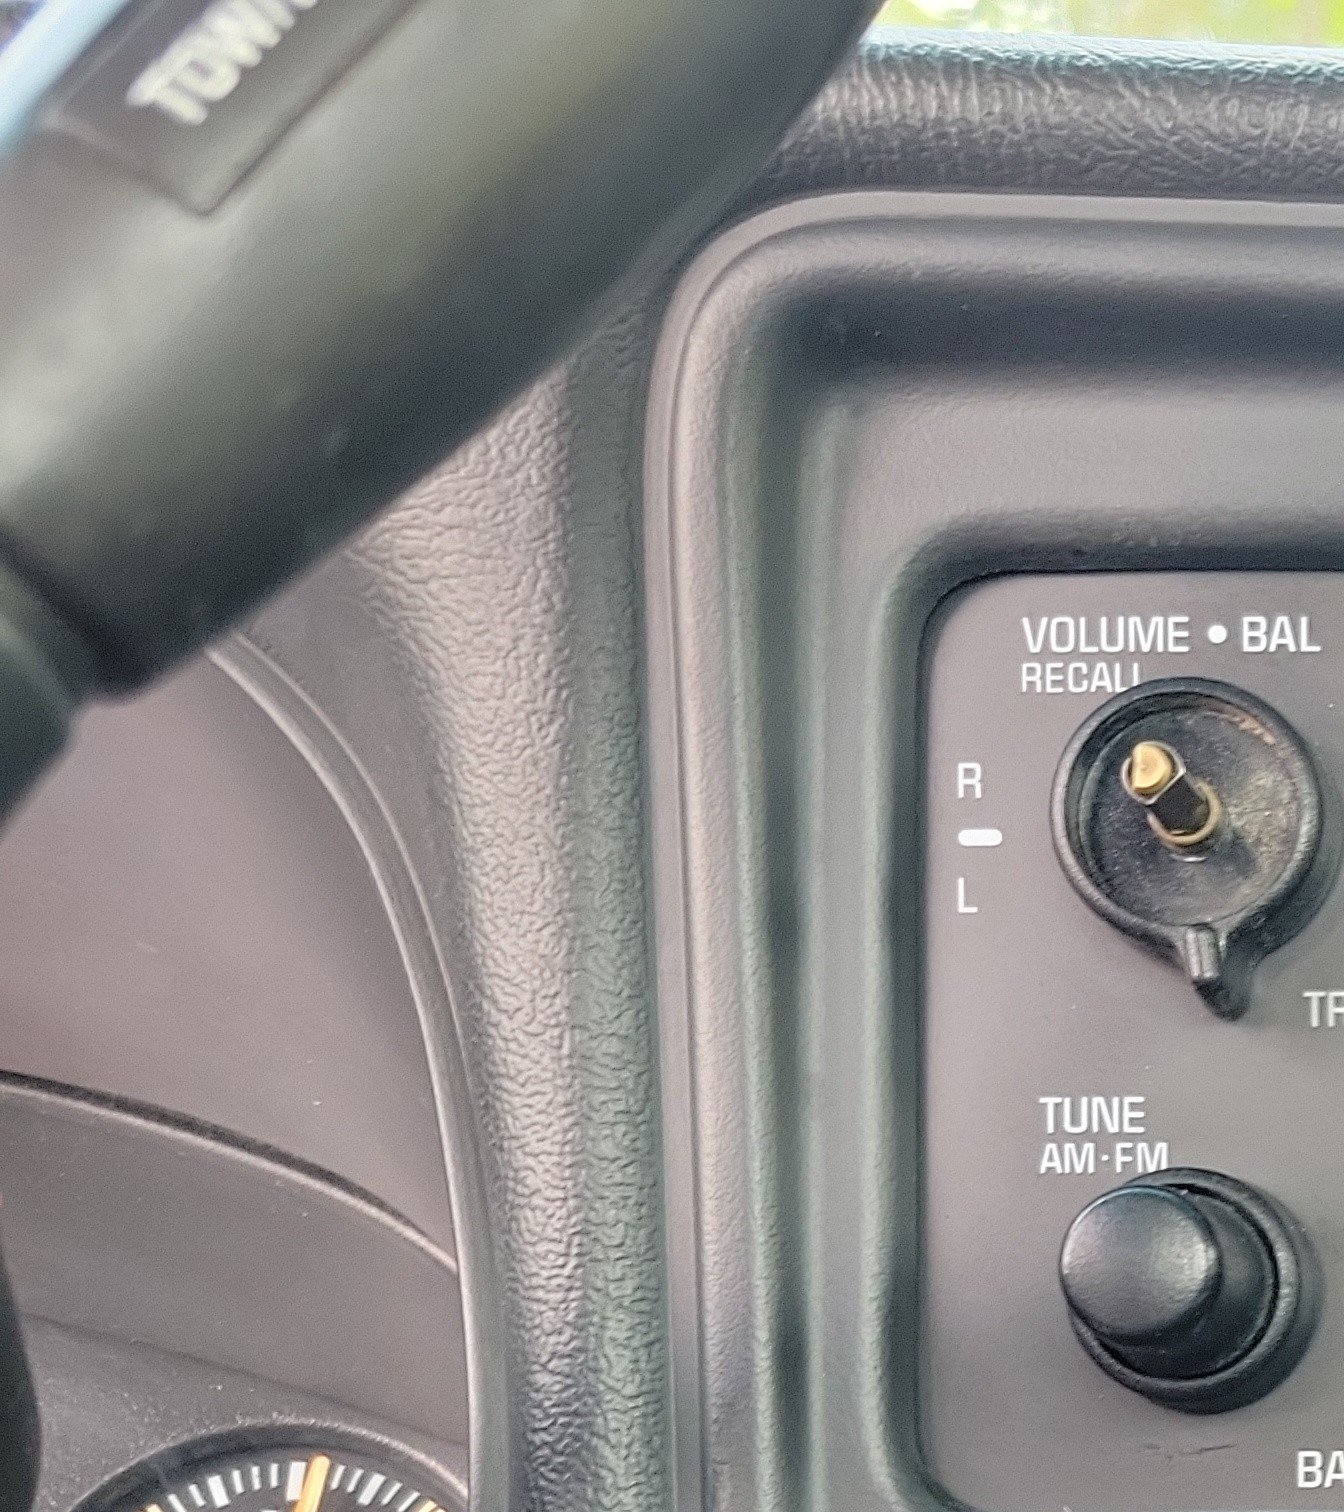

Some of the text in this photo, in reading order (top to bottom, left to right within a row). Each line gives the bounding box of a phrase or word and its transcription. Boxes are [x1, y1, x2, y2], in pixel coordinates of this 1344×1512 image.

[1021, 615, 1322, 653] VOLUME BAL
[957, 762, 982, 799] R
[957, 877, 978, 914] L
[1038, 1096, 1145, 1134] TUNE
